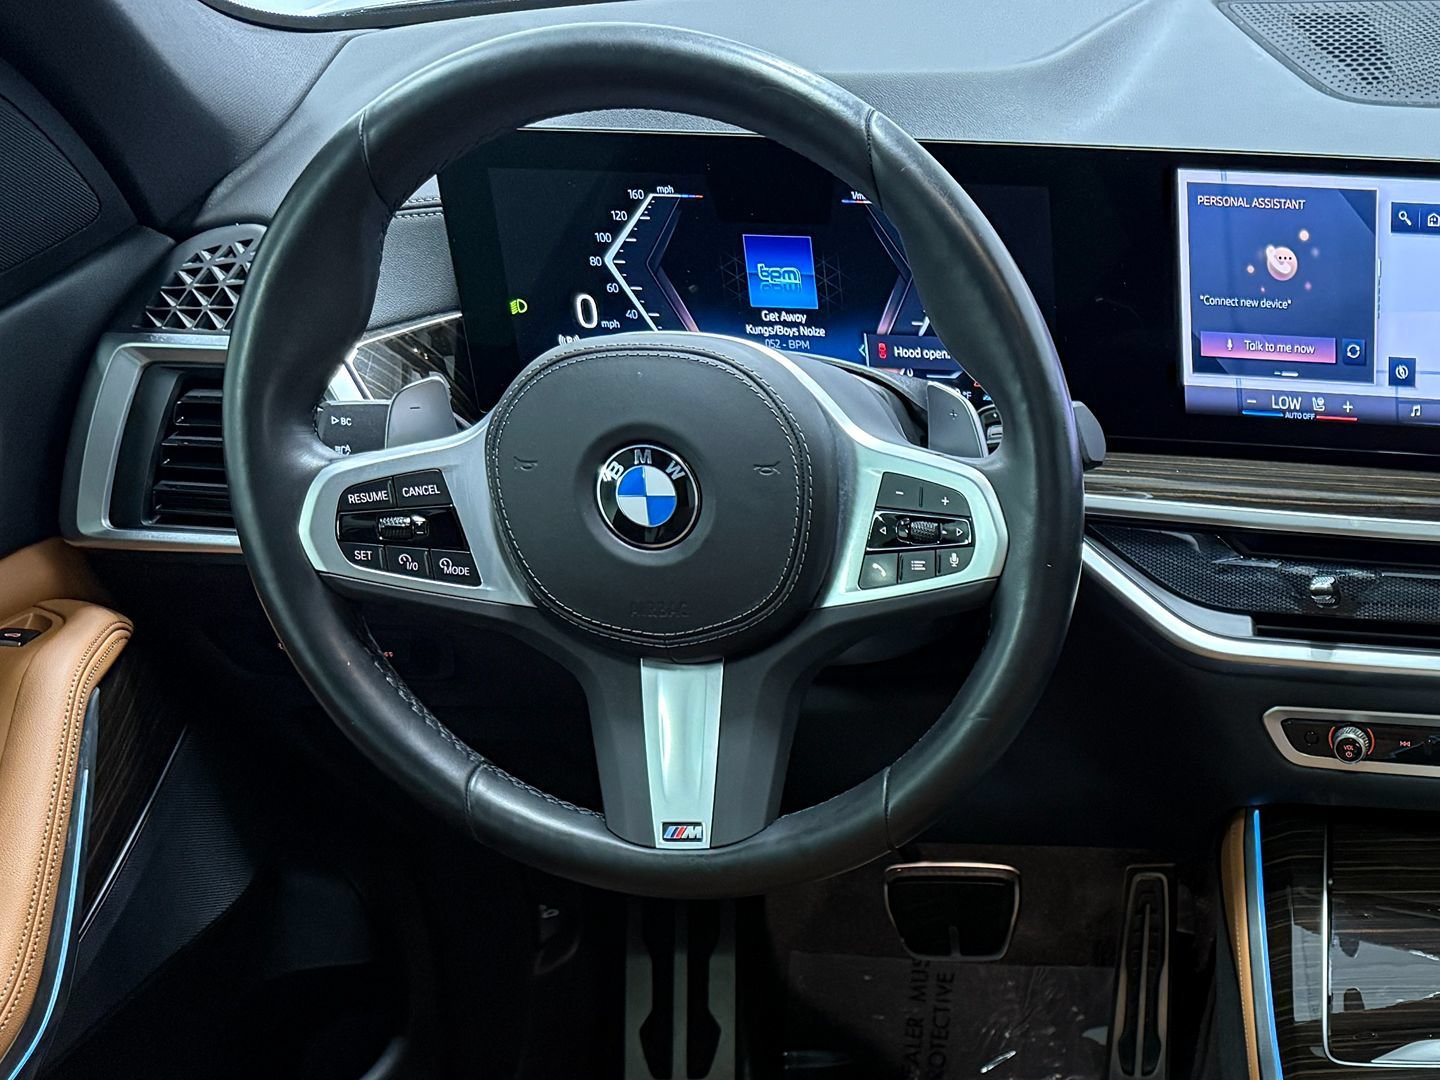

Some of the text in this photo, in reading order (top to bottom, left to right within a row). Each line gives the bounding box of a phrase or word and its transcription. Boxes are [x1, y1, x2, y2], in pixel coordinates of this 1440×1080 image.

[627, 189, 645, 200] 160
[656, 185, 675, 194] mph
[1197, 194, 1306, 210] PERSONAL ASSISTANT
[610, 210, 628, 221] 120
[594, 232, 612, 243] 100
[589, 256, 603, 267] 80
[757, 263, 802, 284] bpm
[606, 283, 619, 293] 60
[1240, 298, 1259, 308] new
[575, 293, 599, 329] 0
[625, 309, 638, 320] 40
[761, 310, 807, 324] Get Away
[601, 319, 620, 330] mph
[745, 324, 826, 337] Kungs/Boys Noize
[788, 340, 810, 350] BPM
[1244, 339, 1316, 355] Talk to me now
[893, 345, 951, 361] Hood open.
[1271, 394, 1302, 410] LOW
[340, 417, 352, 426] BC
[1285, 411, 1315, 421] AUTO OFF
[603, 448, 686, 481] BMW
[402, 483, 441, 498] CANCEL
[348, 489, 389, 504] RESUME
[354, 550, 373, 562] SET
[443, 565, 471, 576] MODE
